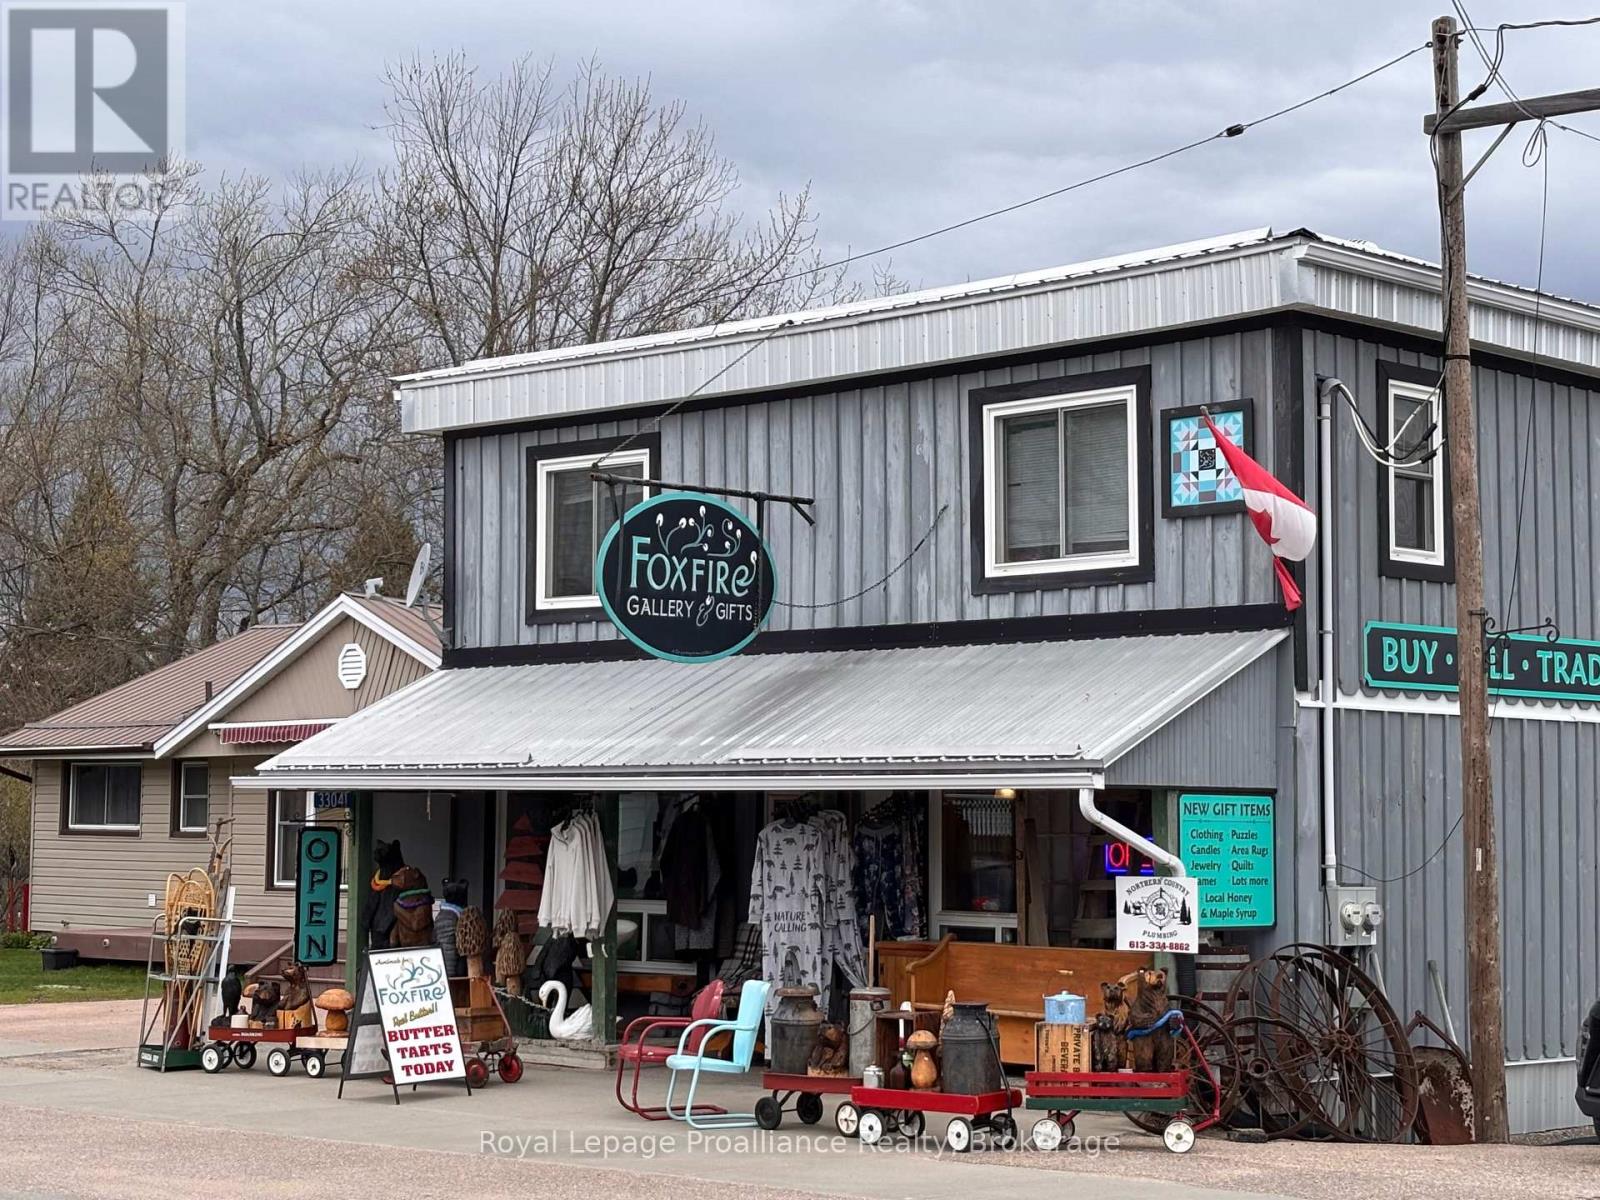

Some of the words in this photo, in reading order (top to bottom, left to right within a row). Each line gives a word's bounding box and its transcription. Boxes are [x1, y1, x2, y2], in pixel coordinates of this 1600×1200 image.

[626, 594, 695, 618] GALLERY
[715, 602, 753, 621] GIFTS
[1382, 636, 1438, 675] BUY
[1183, 802, 1209, 816] NEW
[1213, 803, 1237, 816] GIFT
[1240, 803, 1271, 817] ITEMS
[1190, 828, 1224, 842] Clothing
[1231, 829, 1258, 840] Puzzles
[1190, 844, 1221, 855] Candles
[1231, 845, 1249, 855] Area
[1251, 845, 1269, 857] Rugs
[1190, 860, 1222, 872] Jewelry
[1231, 860, 1254, 872] Quilts
[1197, 877, 1217, 886] ames
[1232, 876, 1247, 886] Lots
[1249, 878, 1269, 886] more
[1126, 878, 1162, 896] NORTHERN
[1163, 878, 1190, 897] COUNTRY
[305, 838, 330, 960] OPEN
[1205, 892, 1225, 903] Local
[1227, 892, 1253, 904] Honey
[774, 911, 806, 922] NATURE
[1200, 909, 1208, 918] &
[1209, 908, 1234, 920] Maple
[1235, 908, 1257, 921] Syrup
[774, 922, 807, 932] CALLING
[1142, 930, 1178, 939] PLUMBING
[387, 1024, 455, 1043] BUTTER
[396, 1042, 453, 1059] TARTS
[1072, 1027, 1081, 1065] PRIVATE
[401, 1060, 455, 1077] TODAY
